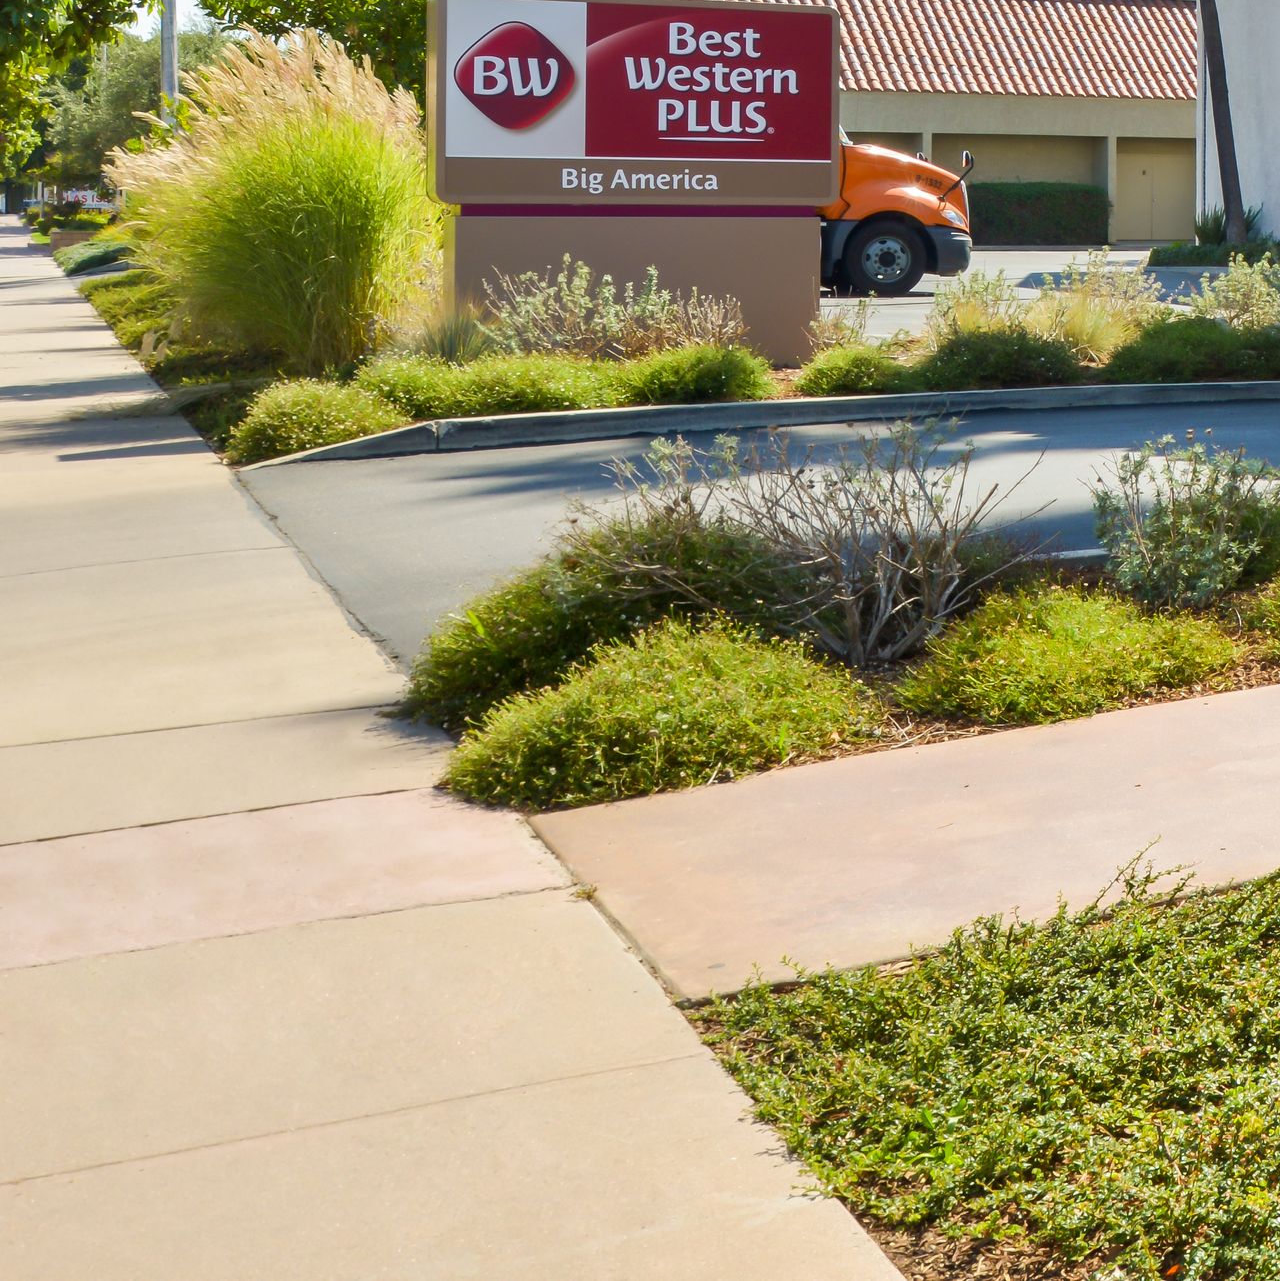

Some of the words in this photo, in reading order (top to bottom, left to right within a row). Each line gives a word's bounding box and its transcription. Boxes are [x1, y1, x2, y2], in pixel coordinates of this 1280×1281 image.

[668, 22, 761, 58] Best
[473, 55, 559, 97] BW
[625, 56, 799, 94] Western
[562, 169, 603, 194] Big
[610, 169, 718, 190] America
